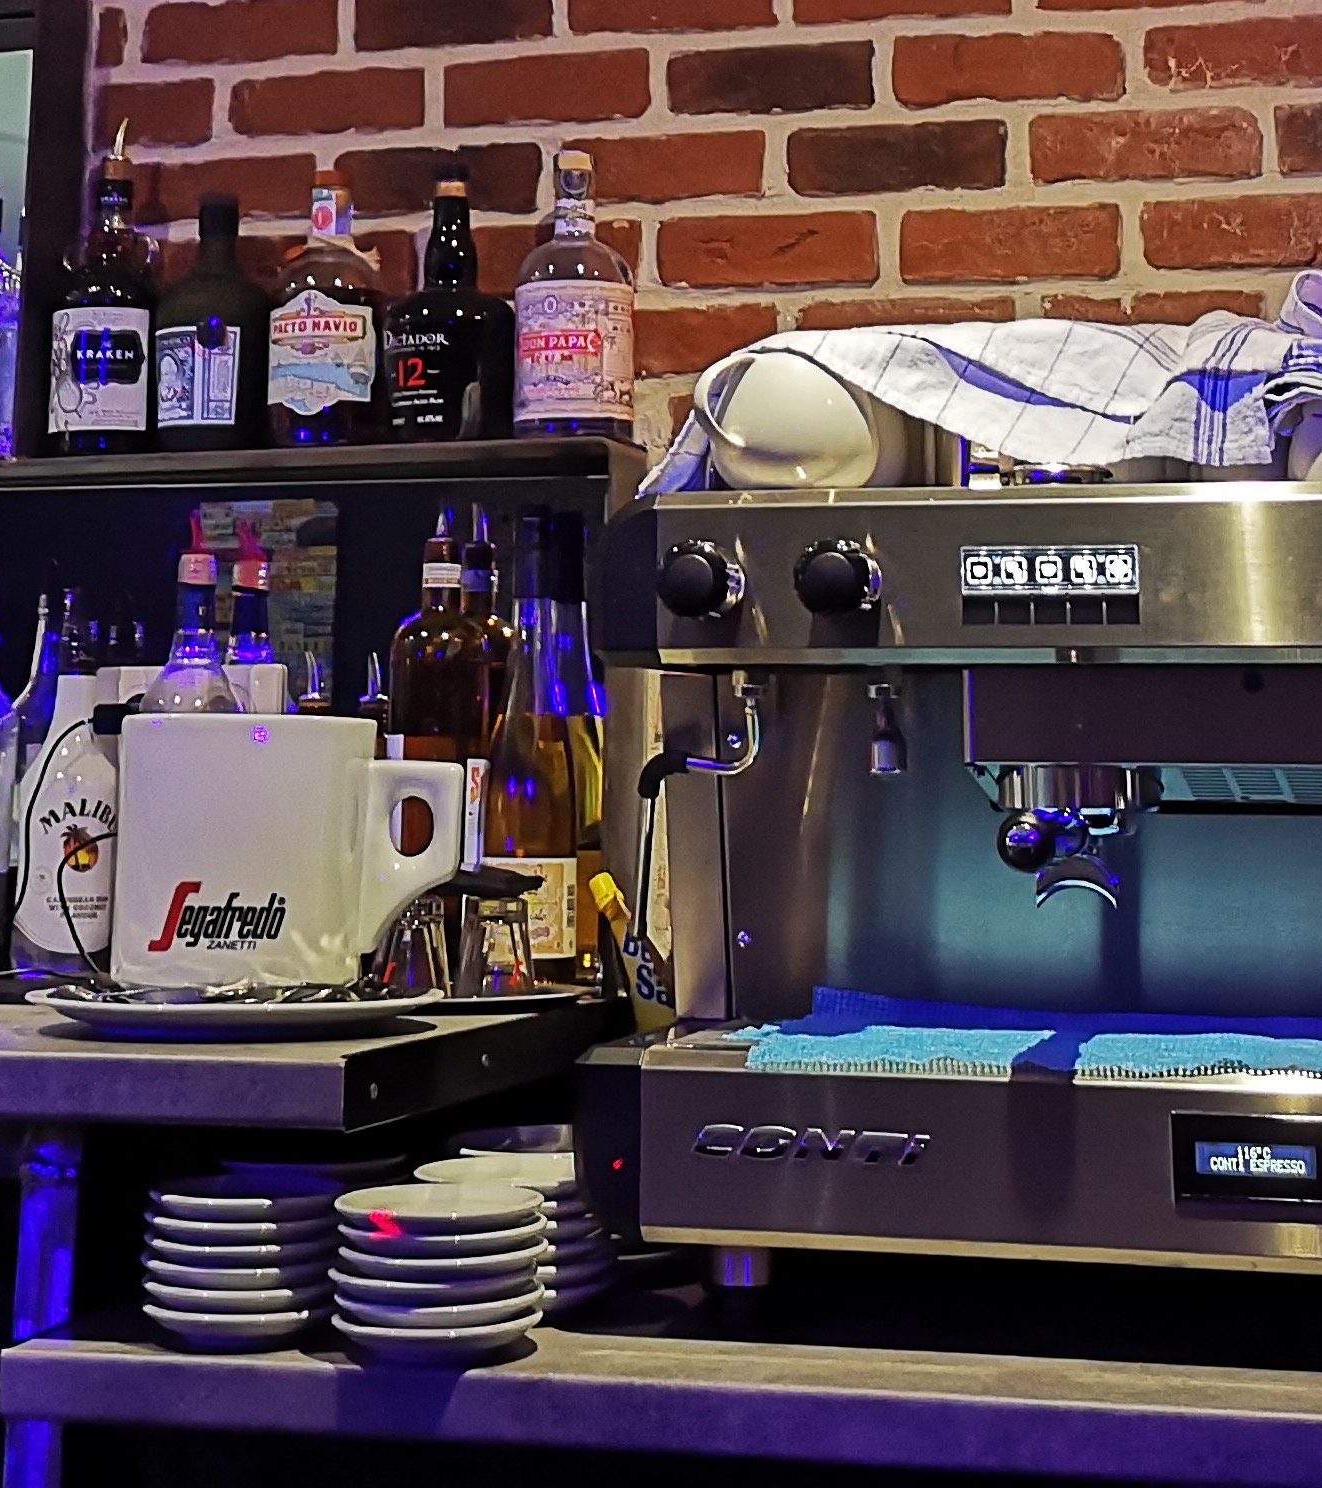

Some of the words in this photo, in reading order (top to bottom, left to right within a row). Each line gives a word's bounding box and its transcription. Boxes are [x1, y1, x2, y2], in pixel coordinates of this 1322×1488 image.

[311, 320, 358, 333] NAVIO
[549, 334, 586, 348] PAPA
[75, 348, 135, 360] KRAKEN
[398, 357, 427, 389] 12
[148, 881, 287, 952] Segafredo
[206, 940, 257, 951] ZANETTI
[691, 1123, 932, 1167] CONTI
[1210, 1157, 1245, 1173] CONTI
[1249, 1159, 1307, 1175] ESPRESSO
